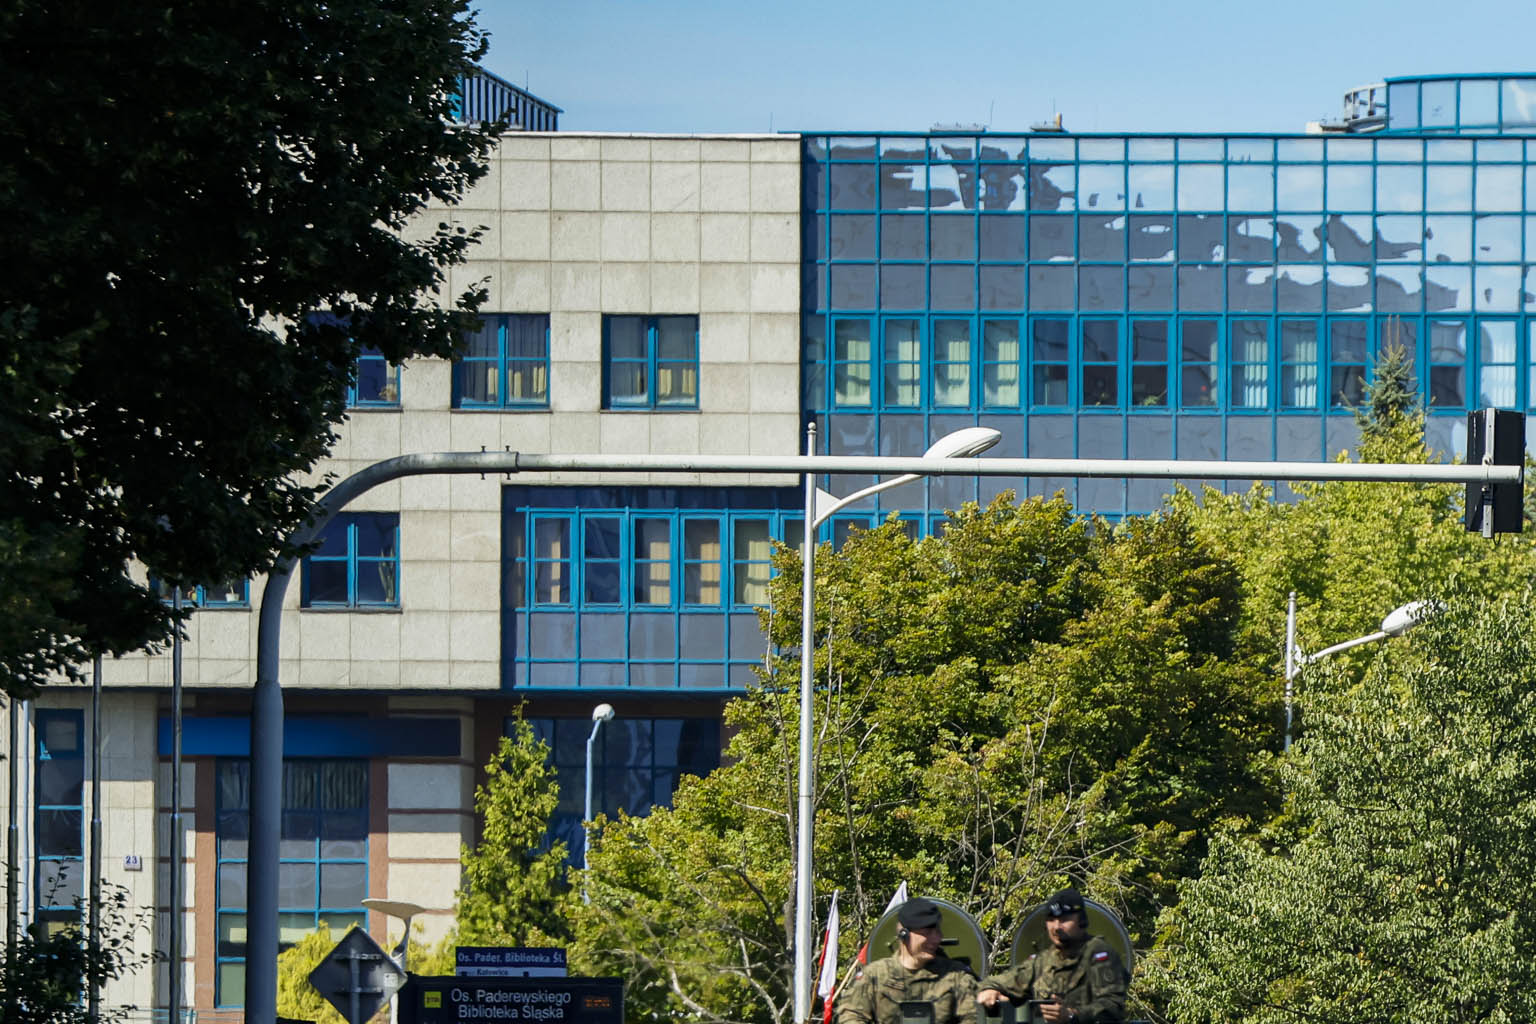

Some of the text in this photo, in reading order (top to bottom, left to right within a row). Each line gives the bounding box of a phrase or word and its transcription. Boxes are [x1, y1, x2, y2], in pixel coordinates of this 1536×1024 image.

[125, 855, 138, 864] 23
[505, 953, 550, 963] Biblioteka
[451, 988, 473, 1003] Os.
[476, 989, 572, 1006] Paderewskiego
[458, 1003, 564, 1021] Biblioteka Śląska
